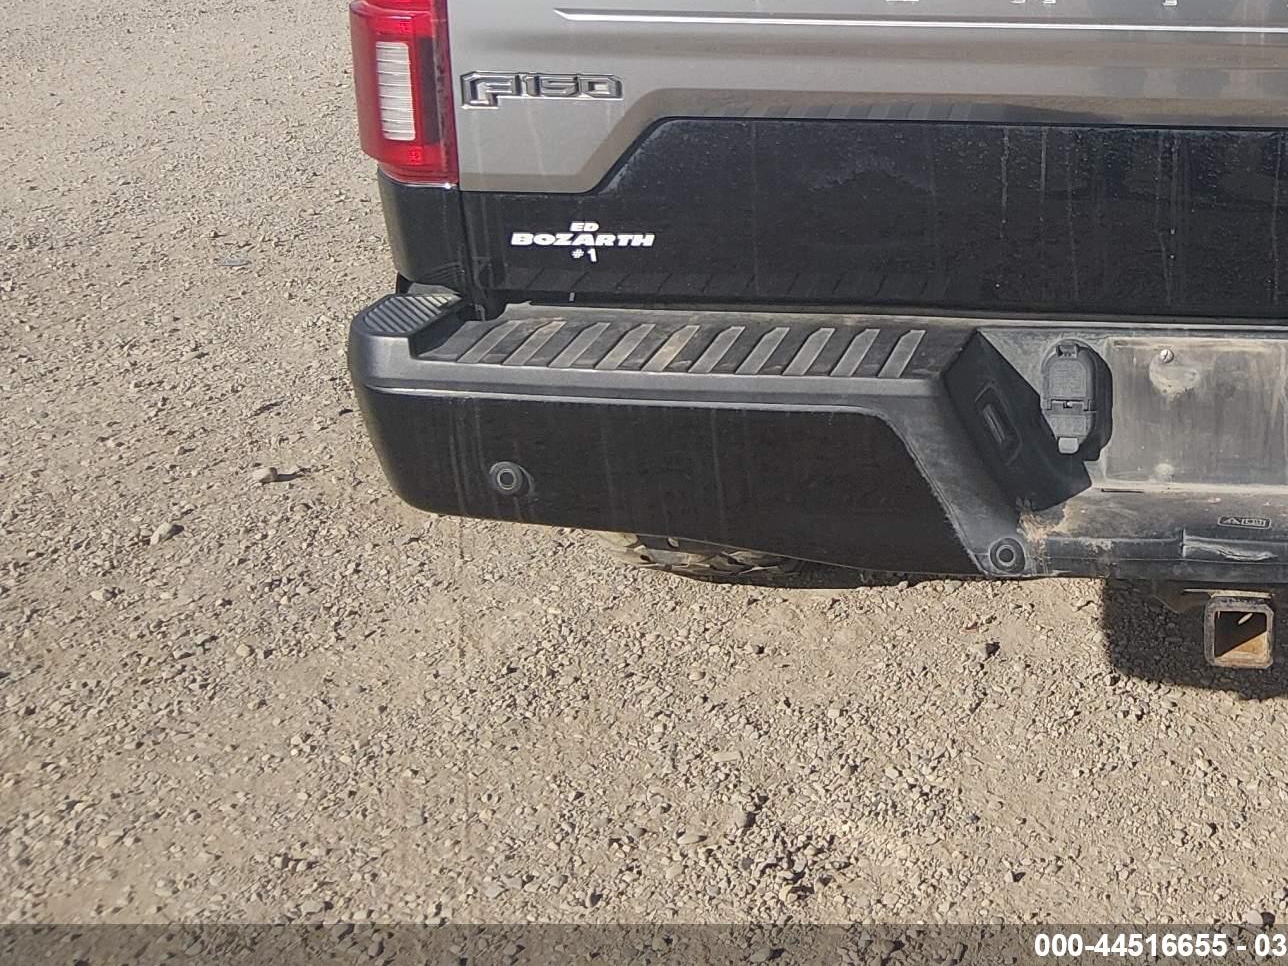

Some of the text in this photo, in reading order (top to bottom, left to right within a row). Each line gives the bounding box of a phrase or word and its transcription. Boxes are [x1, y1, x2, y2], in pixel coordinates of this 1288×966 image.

[570, 222, 600, 232] ED
[511, 232, 655, 247] BOZARTH
[571, 248, 598, 263] #1
